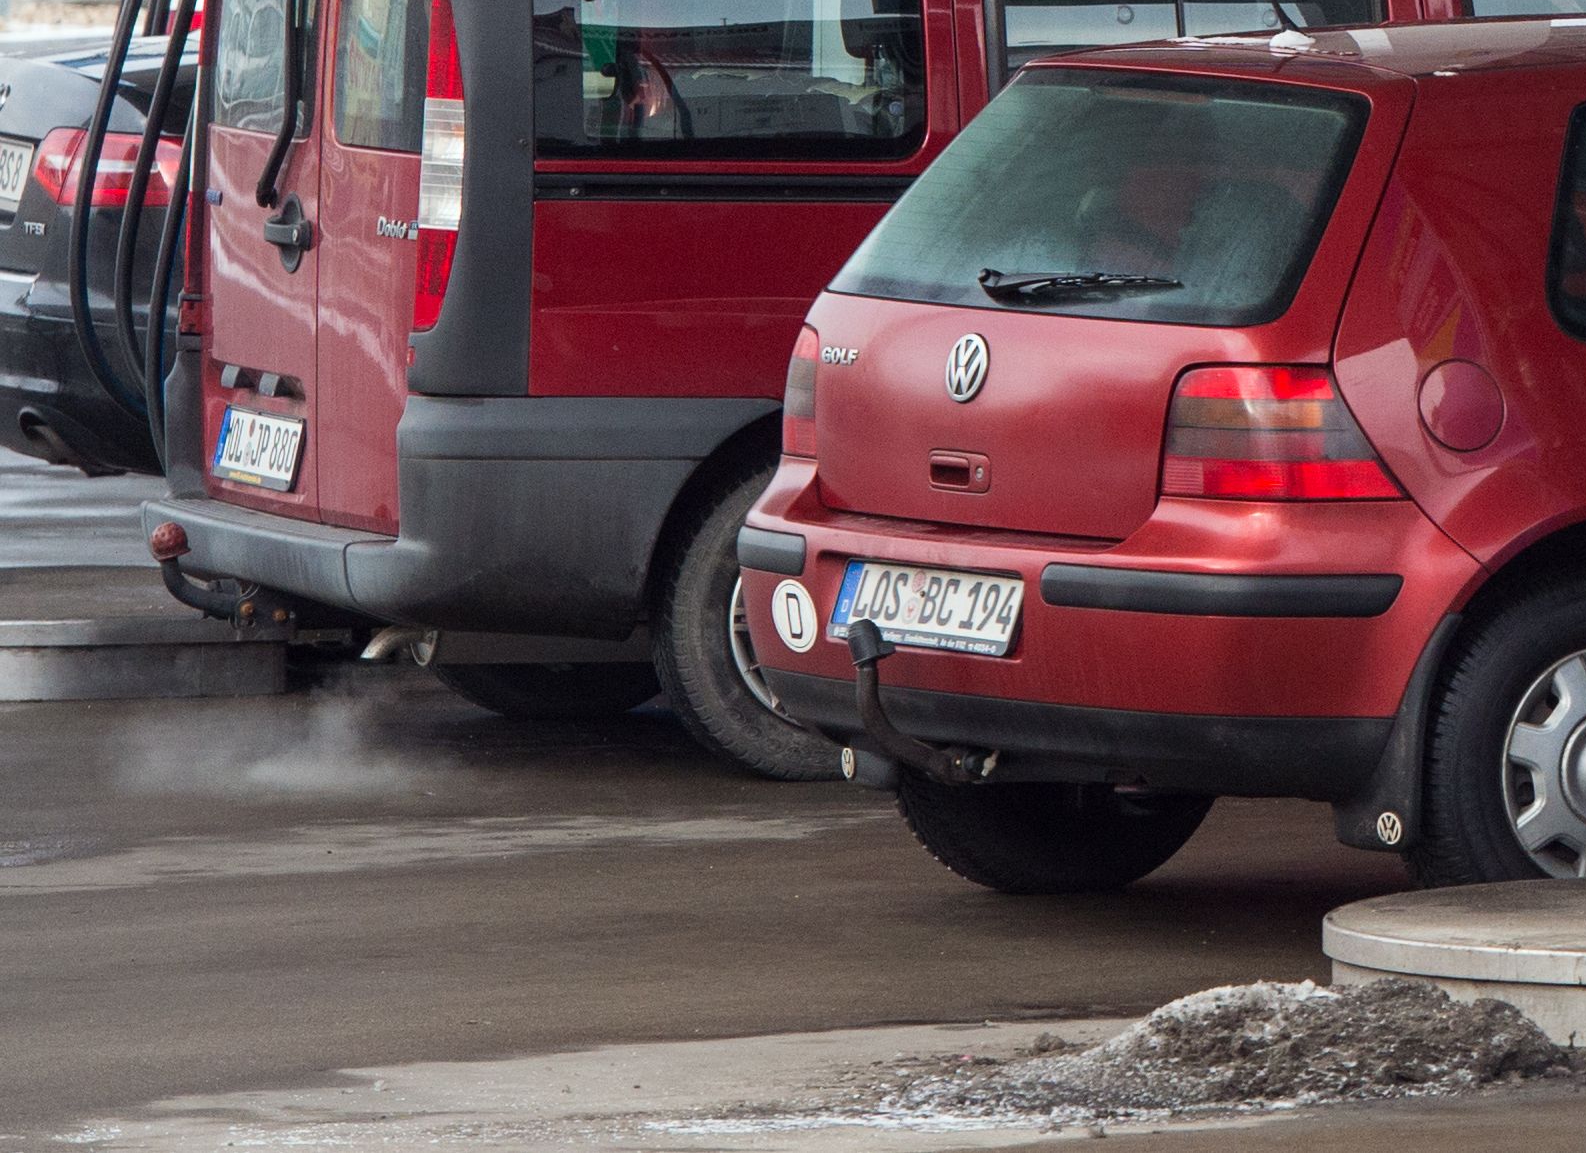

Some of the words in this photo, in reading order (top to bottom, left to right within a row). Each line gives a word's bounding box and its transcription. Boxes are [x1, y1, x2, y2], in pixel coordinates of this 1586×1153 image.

[821, 346, 859, 366] GOLF
[269, 427, 298, 473] 880
[786, 592, 803, 640] D
[852, 569, 909, 622] LOS
[918, 576, 961, 627] BC
[958, 581, 1017, 635] 194
